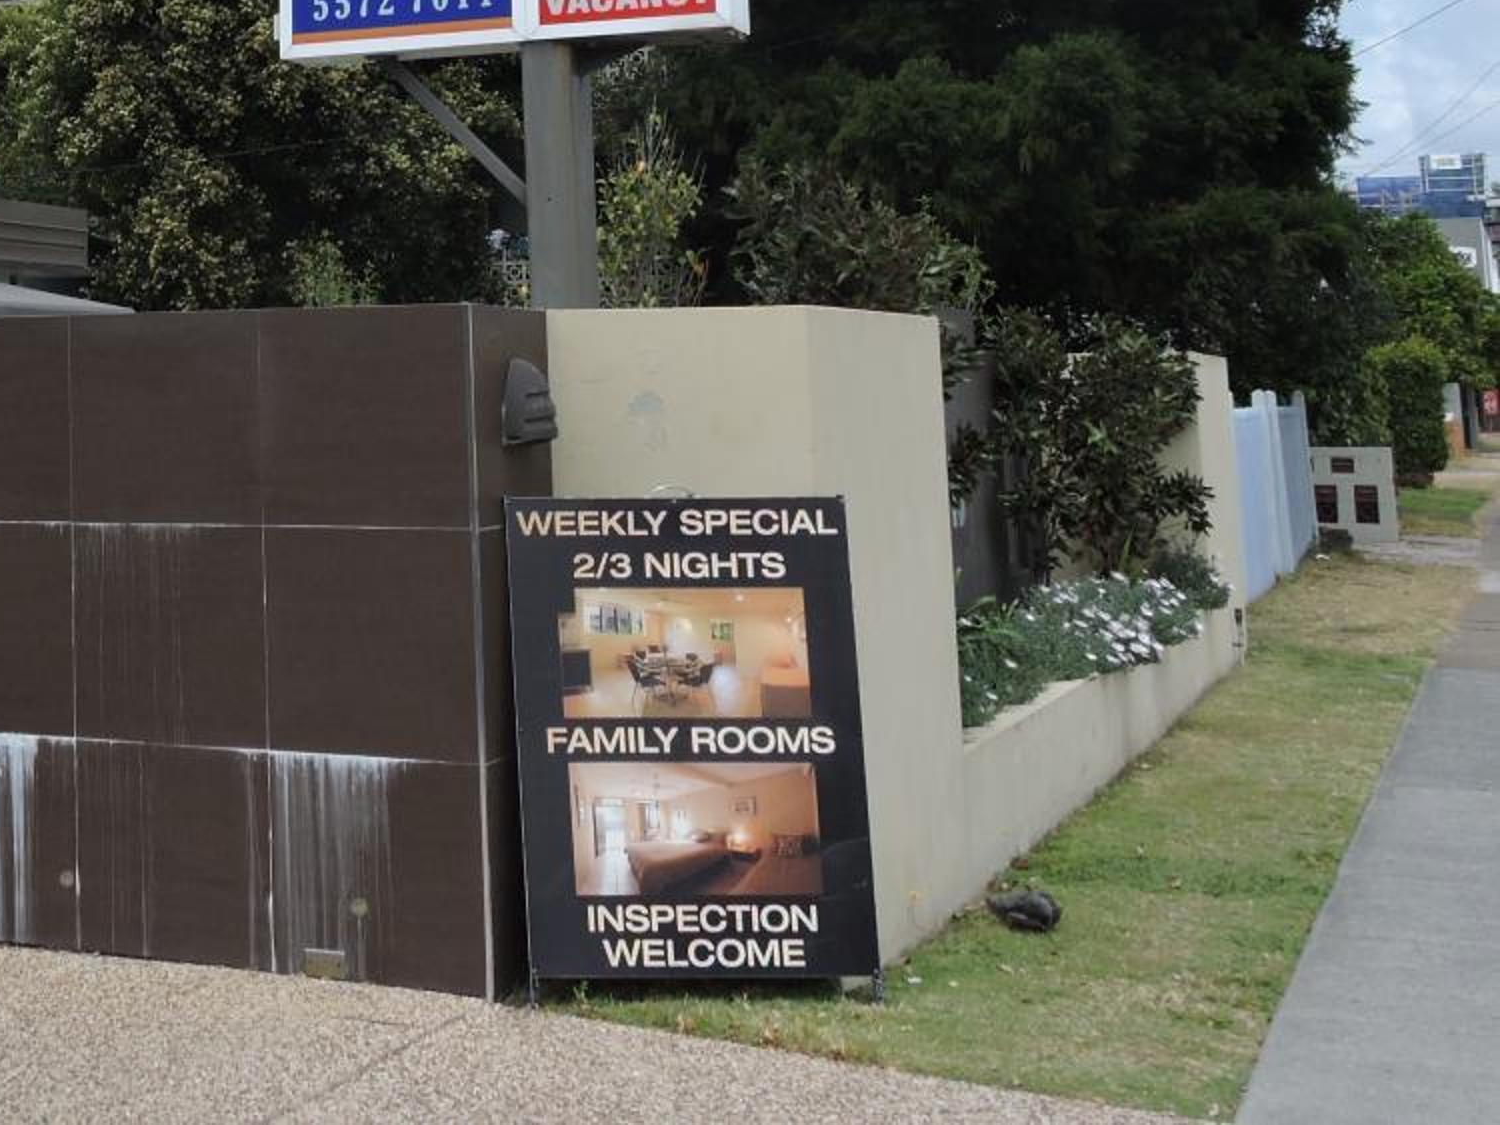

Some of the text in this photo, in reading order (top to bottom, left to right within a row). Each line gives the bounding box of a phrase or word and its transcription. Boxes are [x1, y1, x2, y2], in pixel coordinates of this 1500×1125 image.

[516, 508, 839, 537] WEEKLY SPECIAL
[572, 552, 787, 579] 2/3 NIGHTS
[546, 725, 837, 755] FAMILY ROOMS
[586, 904, 819, 935] INSPECTION
[601, 938, 807, 969] WELCOME
